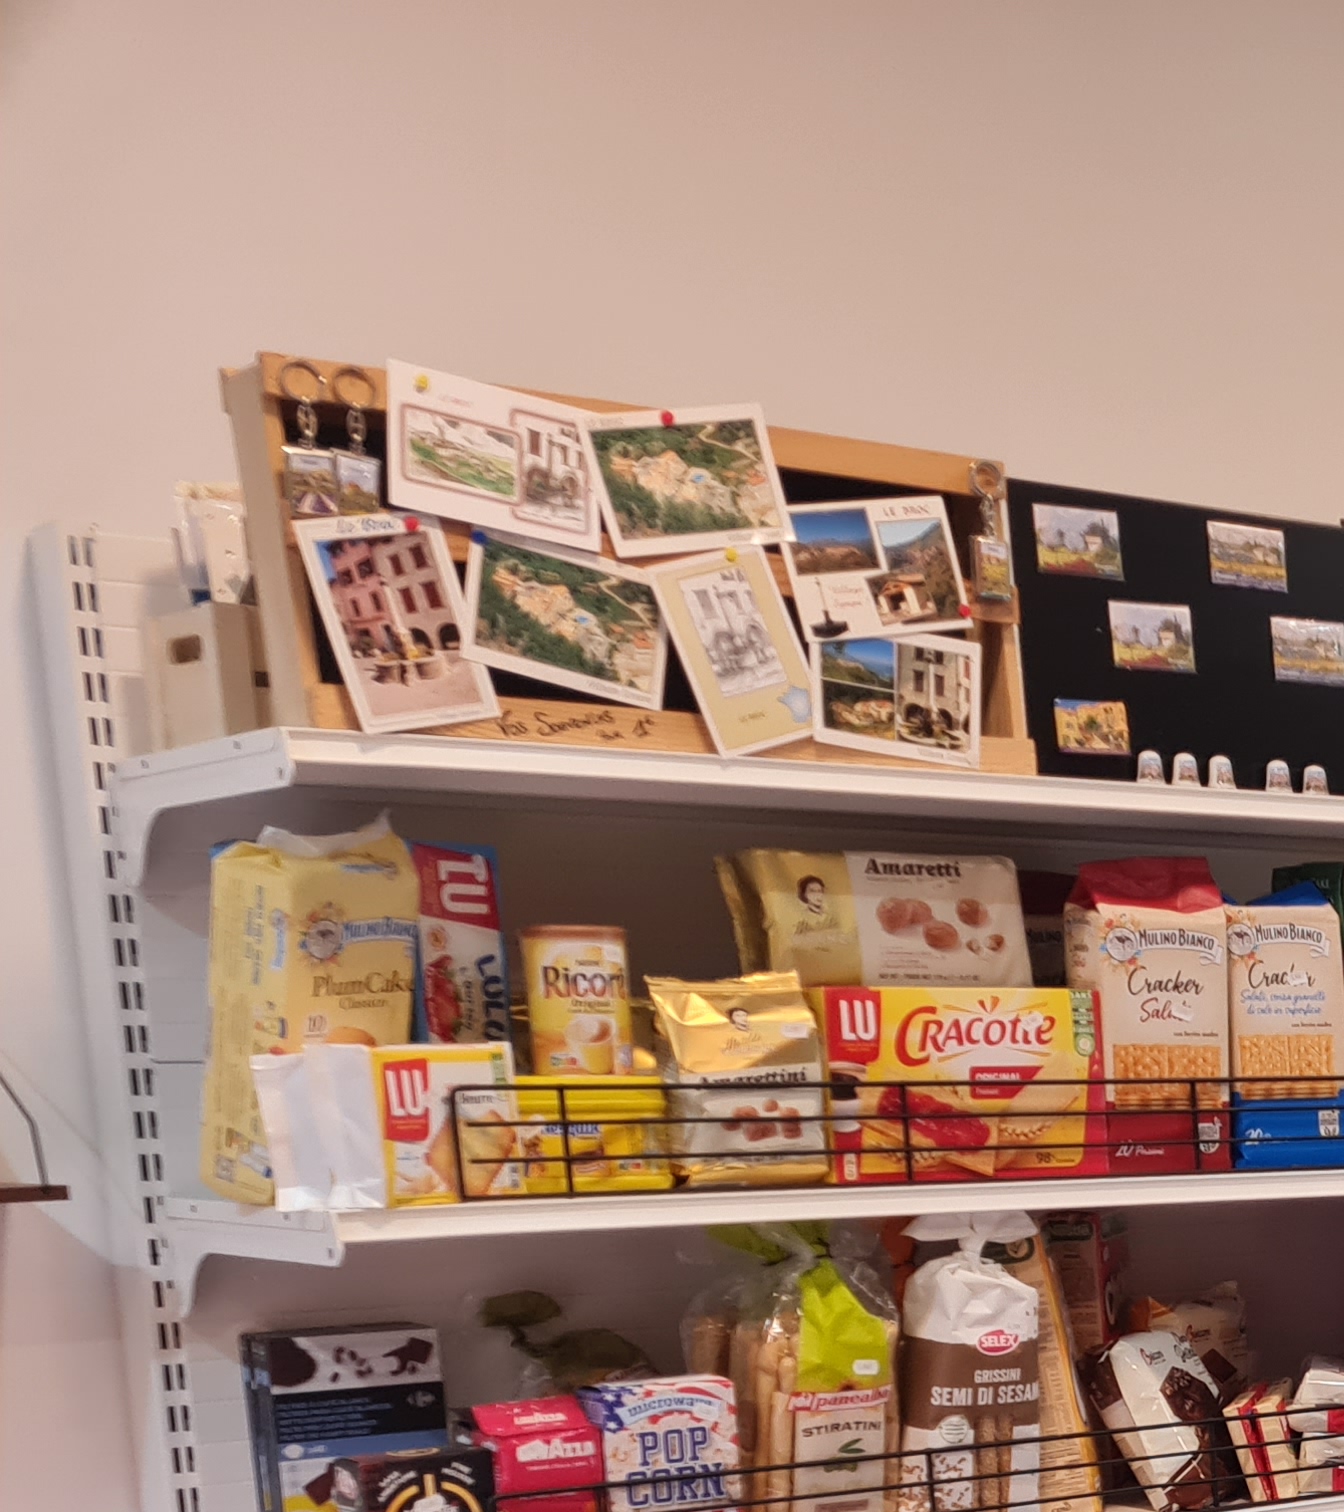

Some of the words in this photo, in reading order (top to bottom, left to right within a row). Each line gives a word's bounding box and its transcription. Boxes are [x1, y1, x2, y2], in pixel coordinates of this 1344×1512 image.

[864, 857, 962, 879] Amaretti
[436, 854, 489, 914] LU
[1127, 966, 1204, 996] Cracker
[839, 999, 877, 1041] LU
[383, 1066, 427, 1118] LU
[979, 1333, 1017, 1348] SELEX
[974, 1368, 1021, 1384] GRISSINI
[930, 1385, 974, 1406] SEMI
[977, 1385, 993, 1405] DI
[996, 1382, 1039, 1404] SESAM
[801, 1420, 882, 1437] STIRATINI
[638, 1427, 709, 1467] POP
[625, 1462, 727, 1508] CORN
